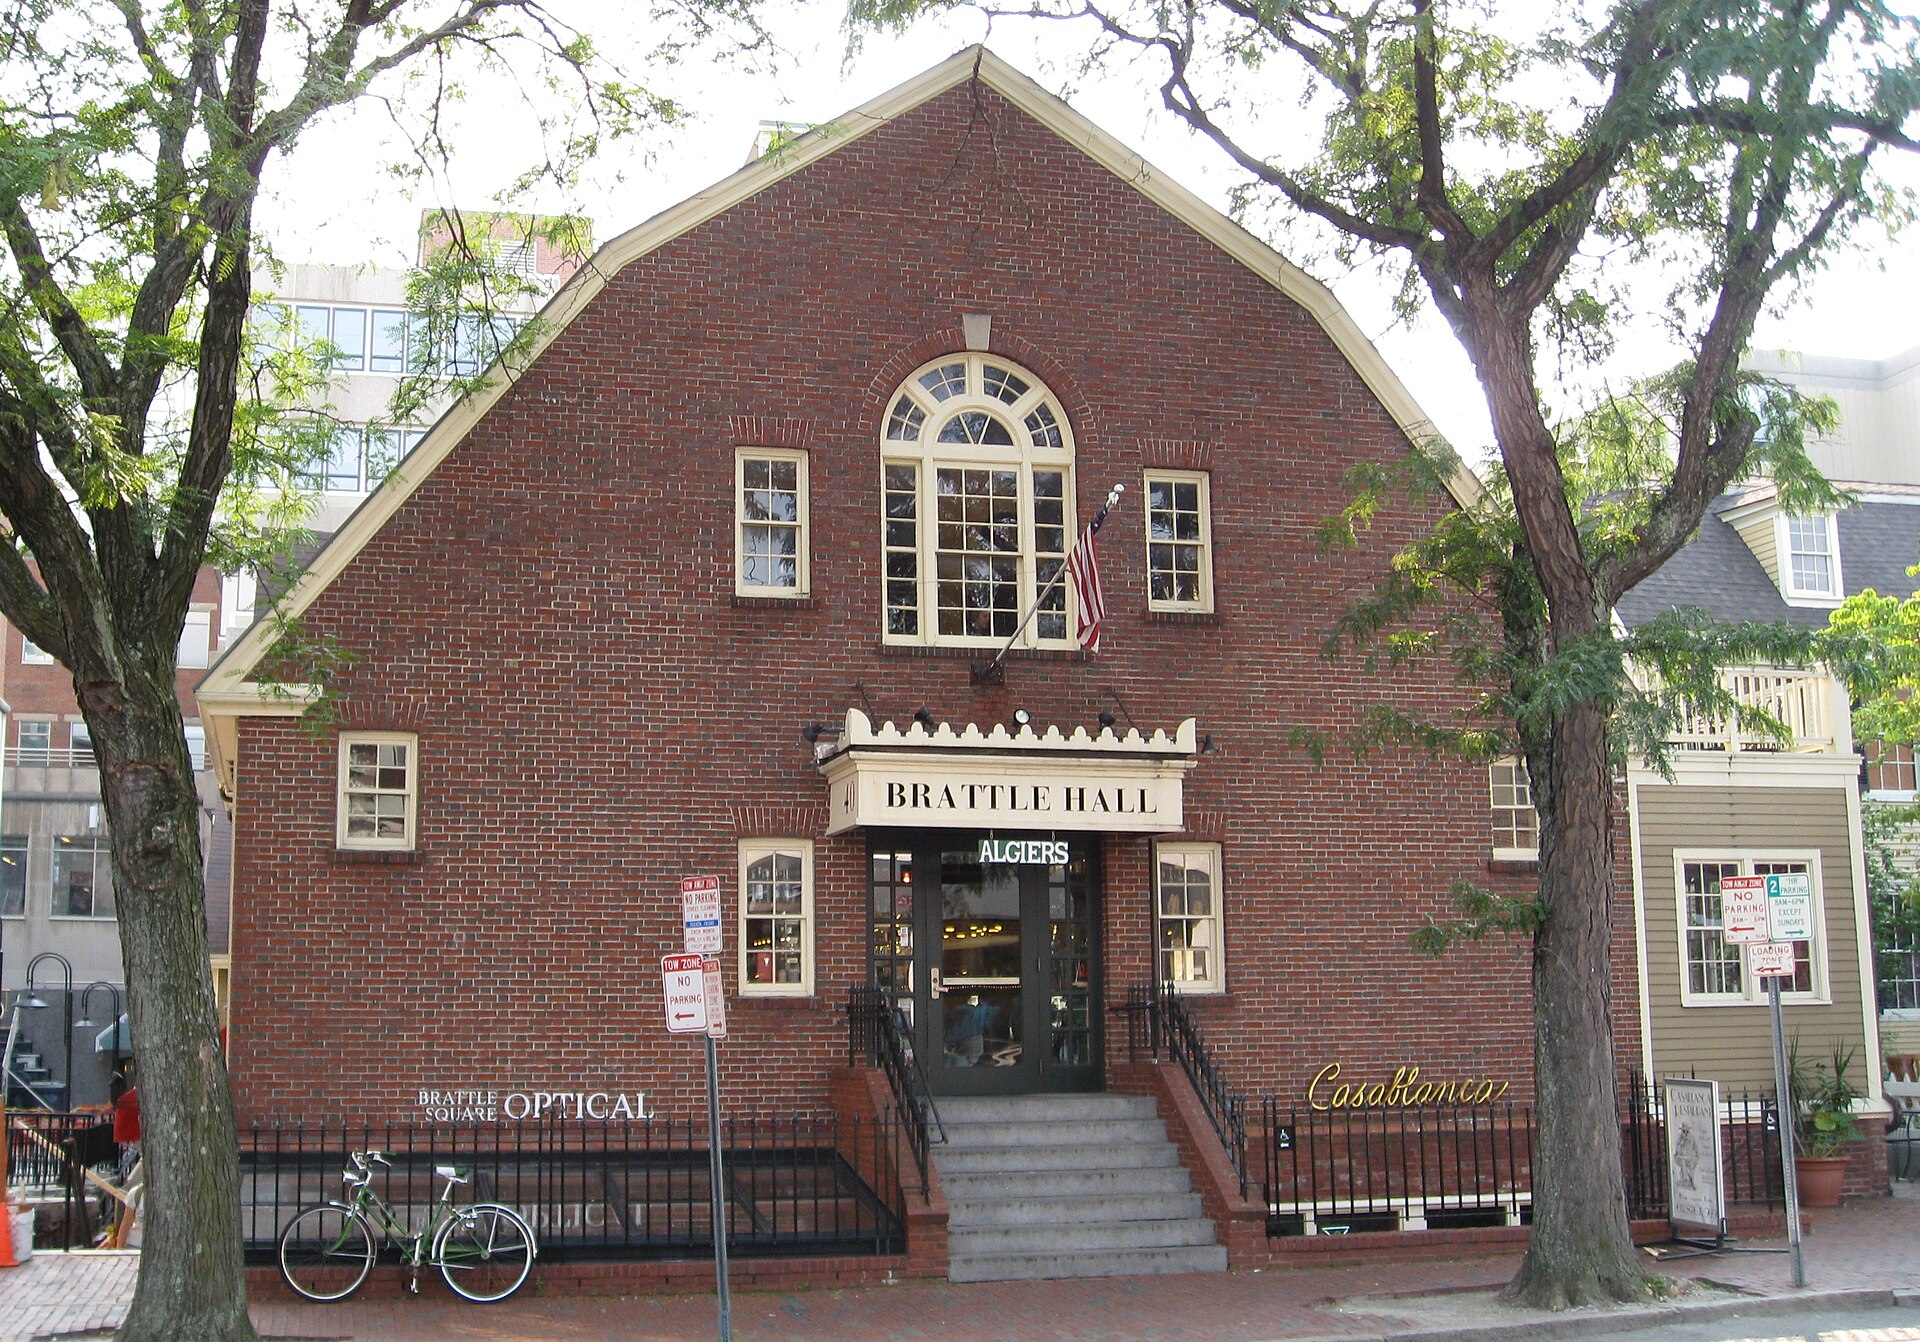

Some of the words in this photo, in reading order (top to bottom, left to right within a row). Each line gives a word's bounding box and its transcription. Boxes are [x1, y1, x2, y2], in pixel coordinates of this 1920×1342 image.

[844, 780, 855, 814] 40
[886, 782, 1051, 811] BRATTLE
[1064, 786, 1157, 814] HALL
[979, 839, 1070, 865] ALGIERS
[1722, 880, 1733, 889] TOW
[1734, 879, 1748, 889] AWAY
[1749, 879, 1763, 888] ZONE
[1770, 880, 1778, 893] 2
[1780, 886, 1808, 894] PARKING
[685, 893, 693, 905] NO
[695, 891, 717, 904] PARKING
[1734, 891, 1753, 901] NO
[1725, 904, 1764, 914] PARKING
[1778, 908, 1802, 916] EXCEPT
[1751, 946, 1789, 956] LOADING
[663, 960, 679, 971] TOW
[681, 957, 701, 969] ZONE
[1761, 956, 1783, 964] ZONE
[677, 975, 691, 987] NO
[669, 994, 702, 1005] PARKING
[1308, 1062, 1509, 1111] Casablanca
[418, 1091, 498, 1105] BRATTLE
[503, 1092, 655, 1120] OPTICAL
[425, 1107, 498, 1122] SQUARE
